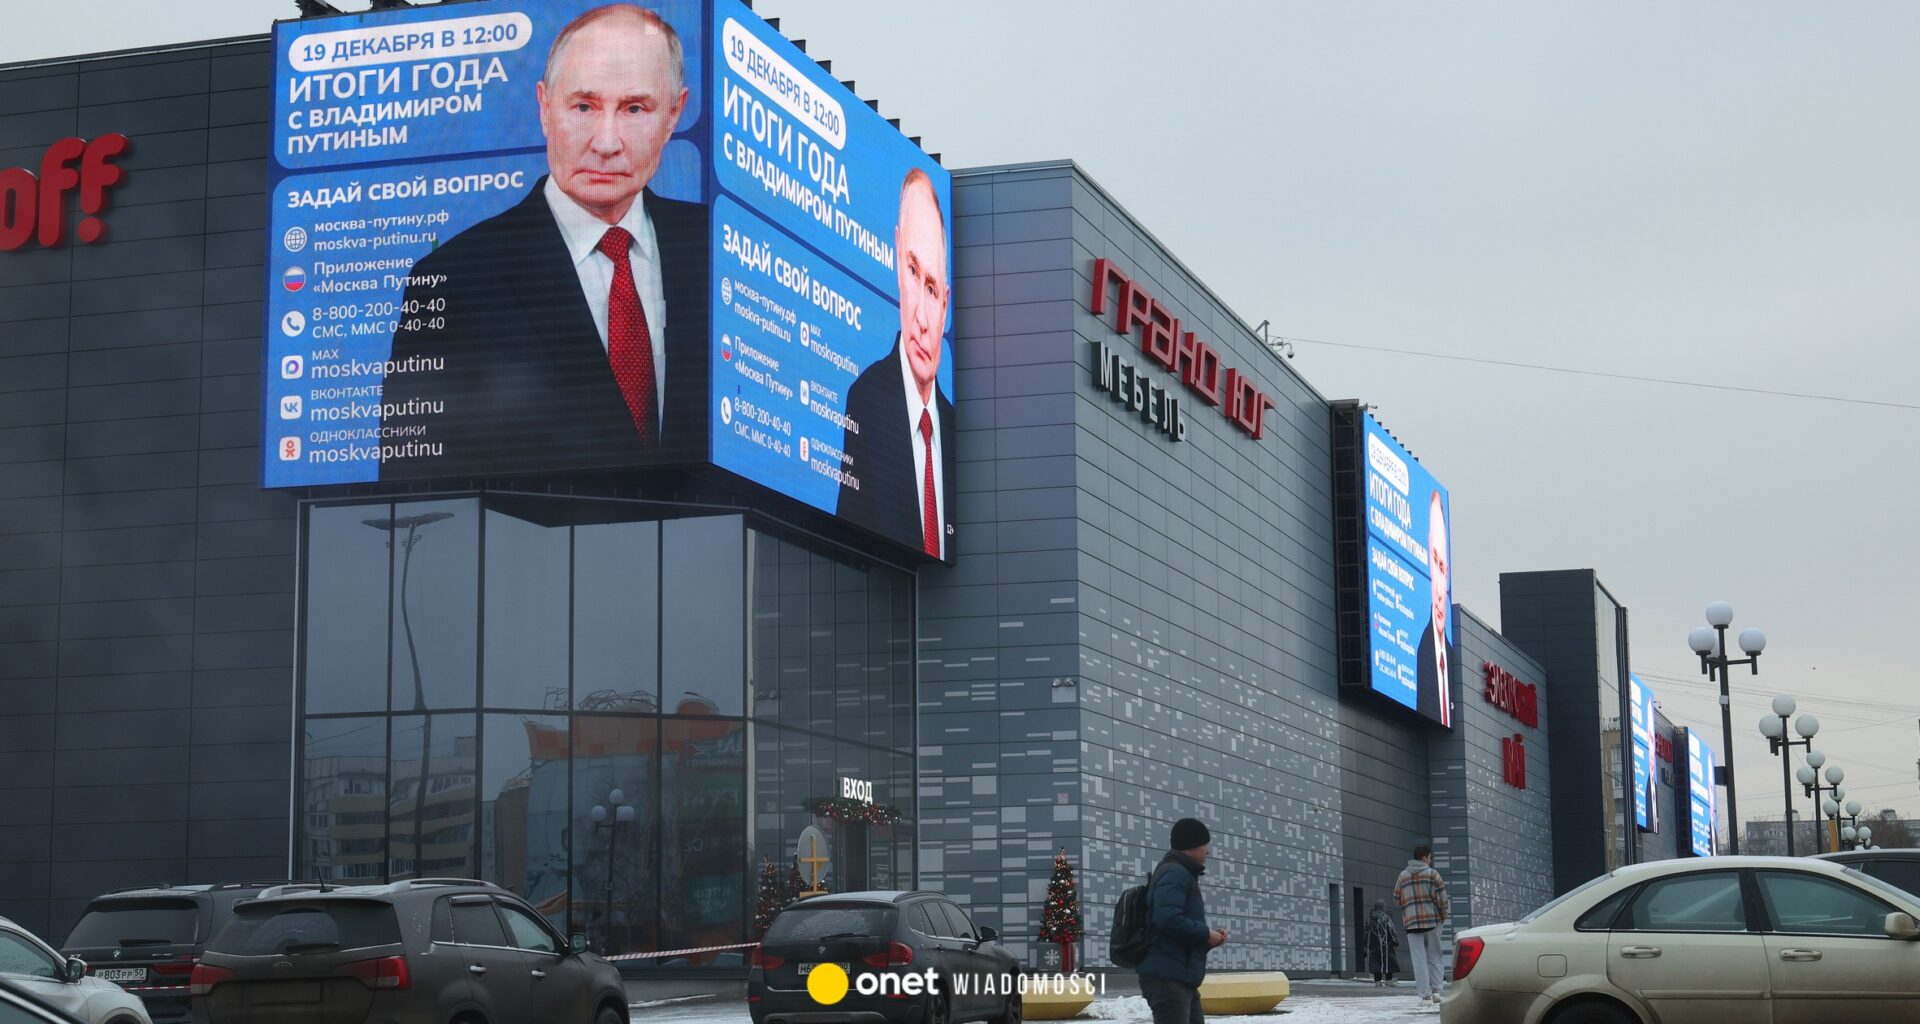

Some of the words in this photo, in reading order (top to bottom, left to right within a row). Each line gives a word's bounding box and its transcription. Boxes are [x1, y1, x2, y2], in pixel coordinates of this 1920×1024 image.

[303, 45, 326, 62] 19
[331, 31, 434, 61] ДЕКАБРЯ
[441, 30, 455, 48] В
[463, 23, 517, 45] 12:00
[289, 66, 401, 102] ИТОГИ
[412, 56, 508, 95] ГОДА
[731, 35, 744, 63] 19
[747, 47, 801, 108] ДЕКАБРЯ
[804, 88, 811, 115] В
[814, 100, 839, 137] 12:00
[288, 111, 302, 129] С
[309, 93, 482, 129] ВЛАДИМИРОМ
[288, 125, 408, 154] ПУТИНЫМ
[723, 77, 792, 163] ИТОГИ
[798, 132, 850, 204] ГОДА
[288, 181, 361, 209] ЗАДАЙ
[368, 175, 427, 201] СВОЙ
[434, 171, 524, 196] ВОПРОС
[724, 132, 733, 160] С
[736, 140, 832, 229] ВЛАДИМИРОМ
[835, 205, 894, 271] ПУТИНЫМ
[314, 209, 449, 233] москва-путину.рф
[314, 231, 436, 251] moskva-putinu.ru
[313, 279, 378, 294] «Москва
[383, 274, 448, 291] Путину»
[314, 257, 414, 276] Приложение
[723, 224, 771, 272] ЗАДАЙ
[774, 259, 810, 301] СВОЙ
[813, 280, 862, 331] ВОПРОС
[313, 298, 446, 321] 8-800-200-40-40
[734, 280, 797, 327] москва-путину.рф
[312, 327, 348, 339] СМС,
[351, 322, 386, 336] ММС
[390, 317, 445, 333] 0-40-40
[311, 354, 444, 379] moskvaputinu
[312, 349, 340, 361] MAX
[735, 336, 779, 372] Приложение
[810, 338, 859, 377] moskvaputinu
[311, 386, 384, 400] ВКОНТАКТЕ
[1093, 341, 1186, 441] МЕБЕЛЬ
[1224, 367, 1276, 440] ЮГ
[311, 399, 444, 422] moskvaputinu
[734, 397, 791, 437] 8-800-200-40-40
[810, 400, 859, 435] moskvaputinu
[309, 440, 443, 463] moskvaputinu
[310, 425, 426, 444] ОДНОКЛАССНИКИ
[811, 460, 859, 491] moskvaputinu
[1370, 470, 1392, 514] ИТОГИ
[842, 776, 873, 805] ВХОД
